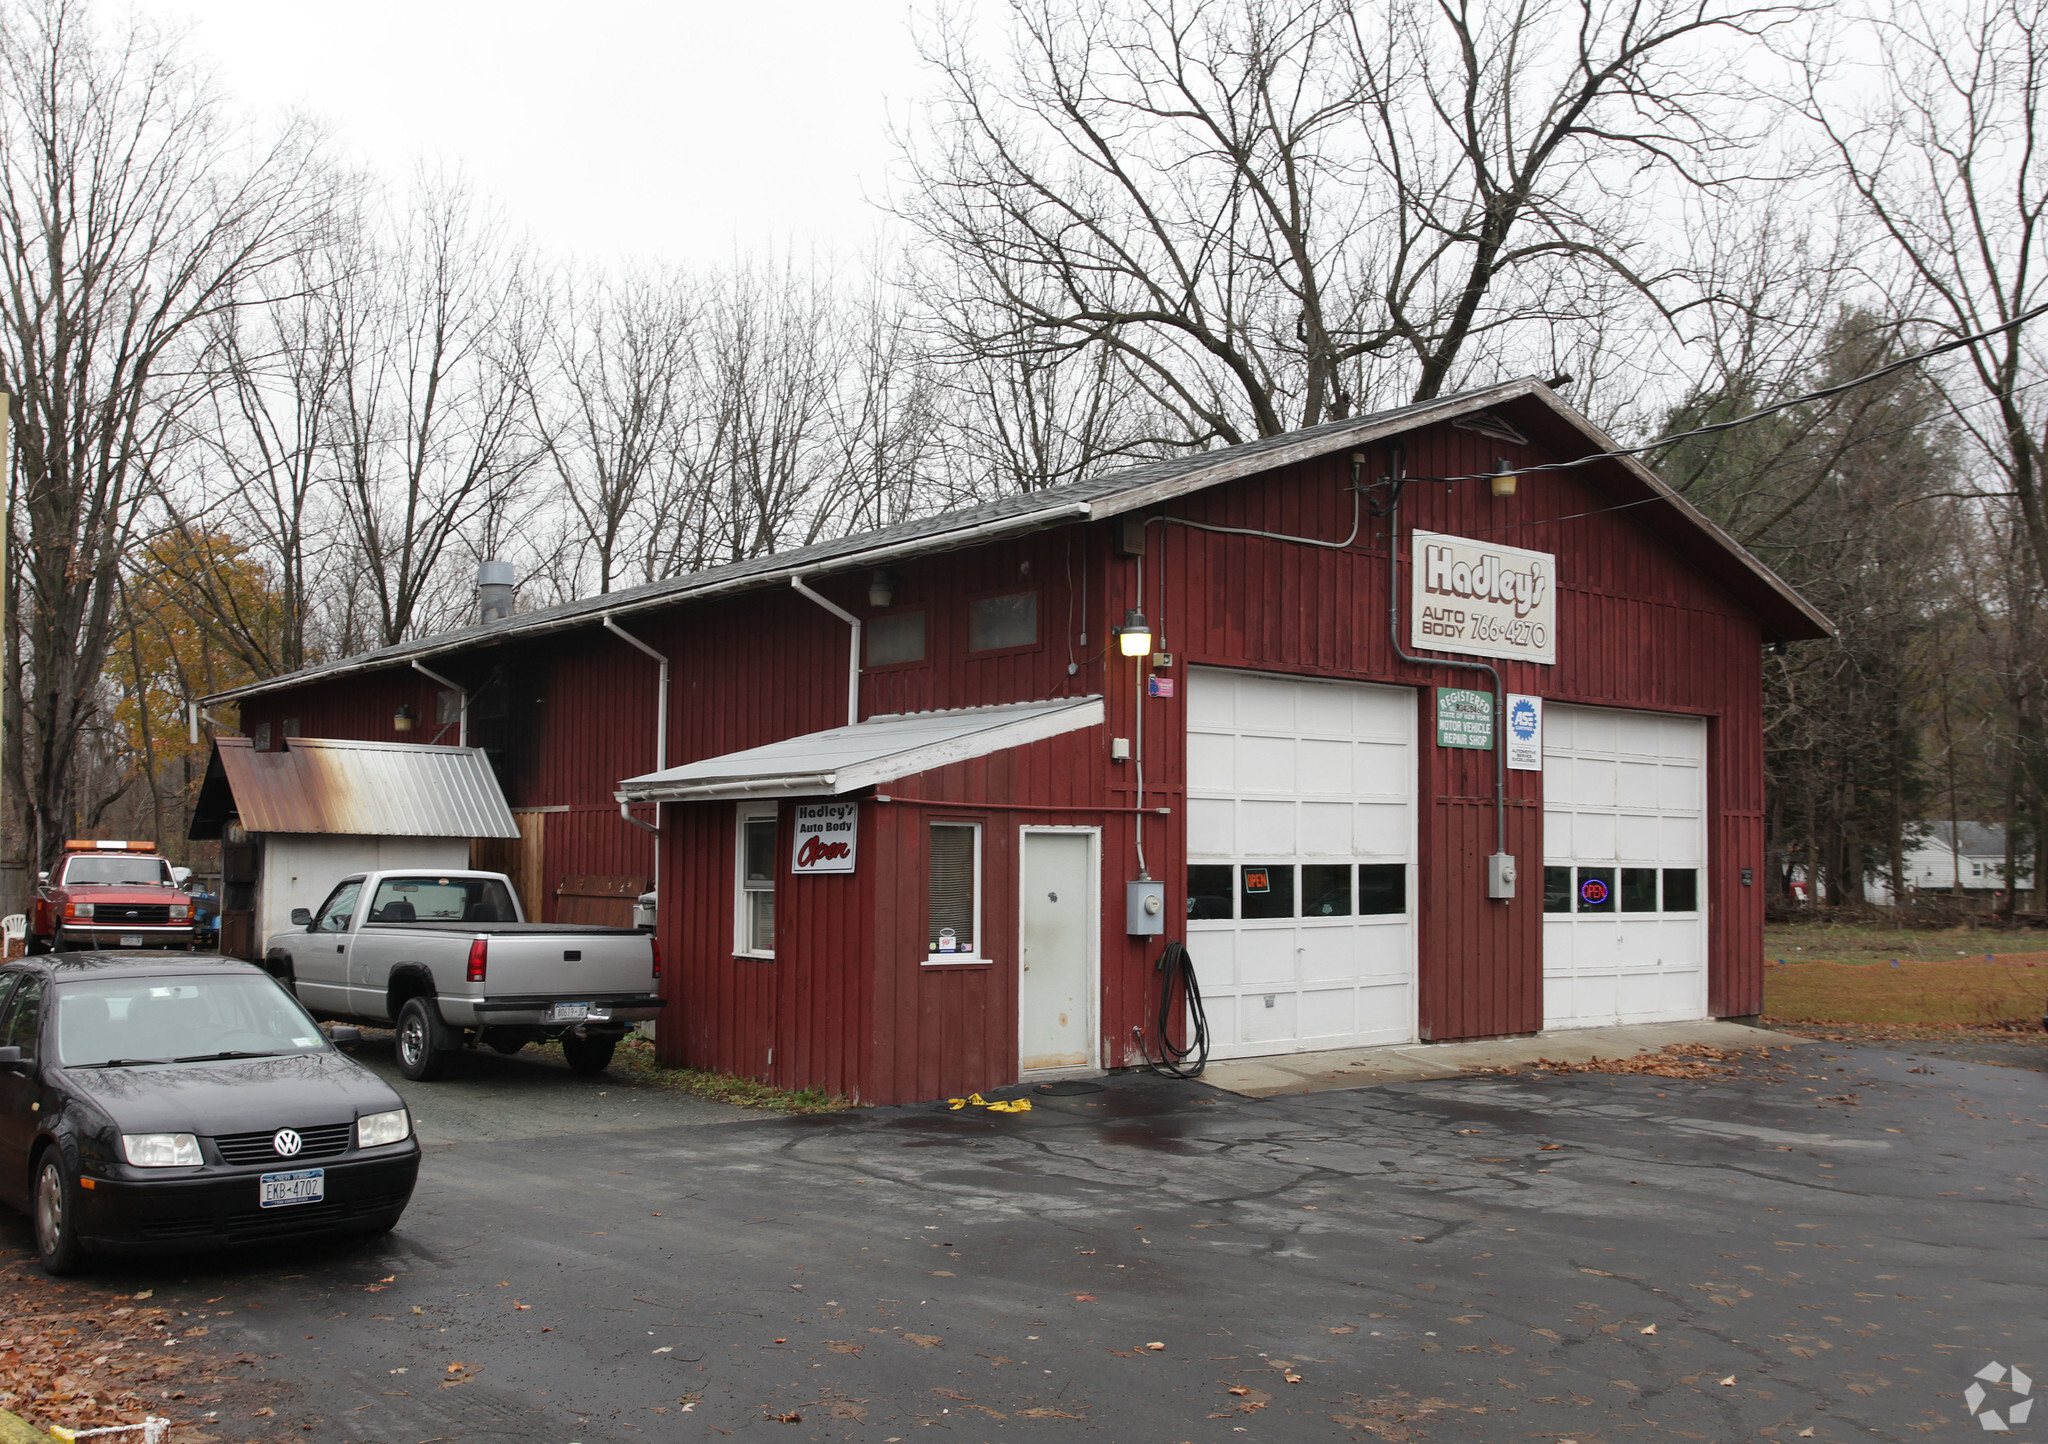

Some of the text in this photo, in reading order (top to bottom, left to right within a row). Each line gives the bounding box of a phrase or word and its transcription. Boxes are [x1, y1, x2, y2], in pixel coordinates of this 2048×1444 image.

[1425, 544, 1546, 618] Hadley's
[1422, 606, 1465, 623] AUTO
[1422, 621, 1465, 638] BODY
[1440, 691, 1490, 713] REGISTERED
[1439, 711, 1455, 719] STATE
[1514, 711, 1534, 726] ASE
[1439, 719, 1491, 734] MOTOR VEHICLE
[1443, 732, 1488, 747] REPAIR SHOP
[799, 804, 854, 820] Hadley's
[800, 821, 852, 833] Auto Body
[797, 835, 851, 867] Open
[1247, 873, 1267, 888] OPEN
[1583, 884, 1606, 898] OPEN
